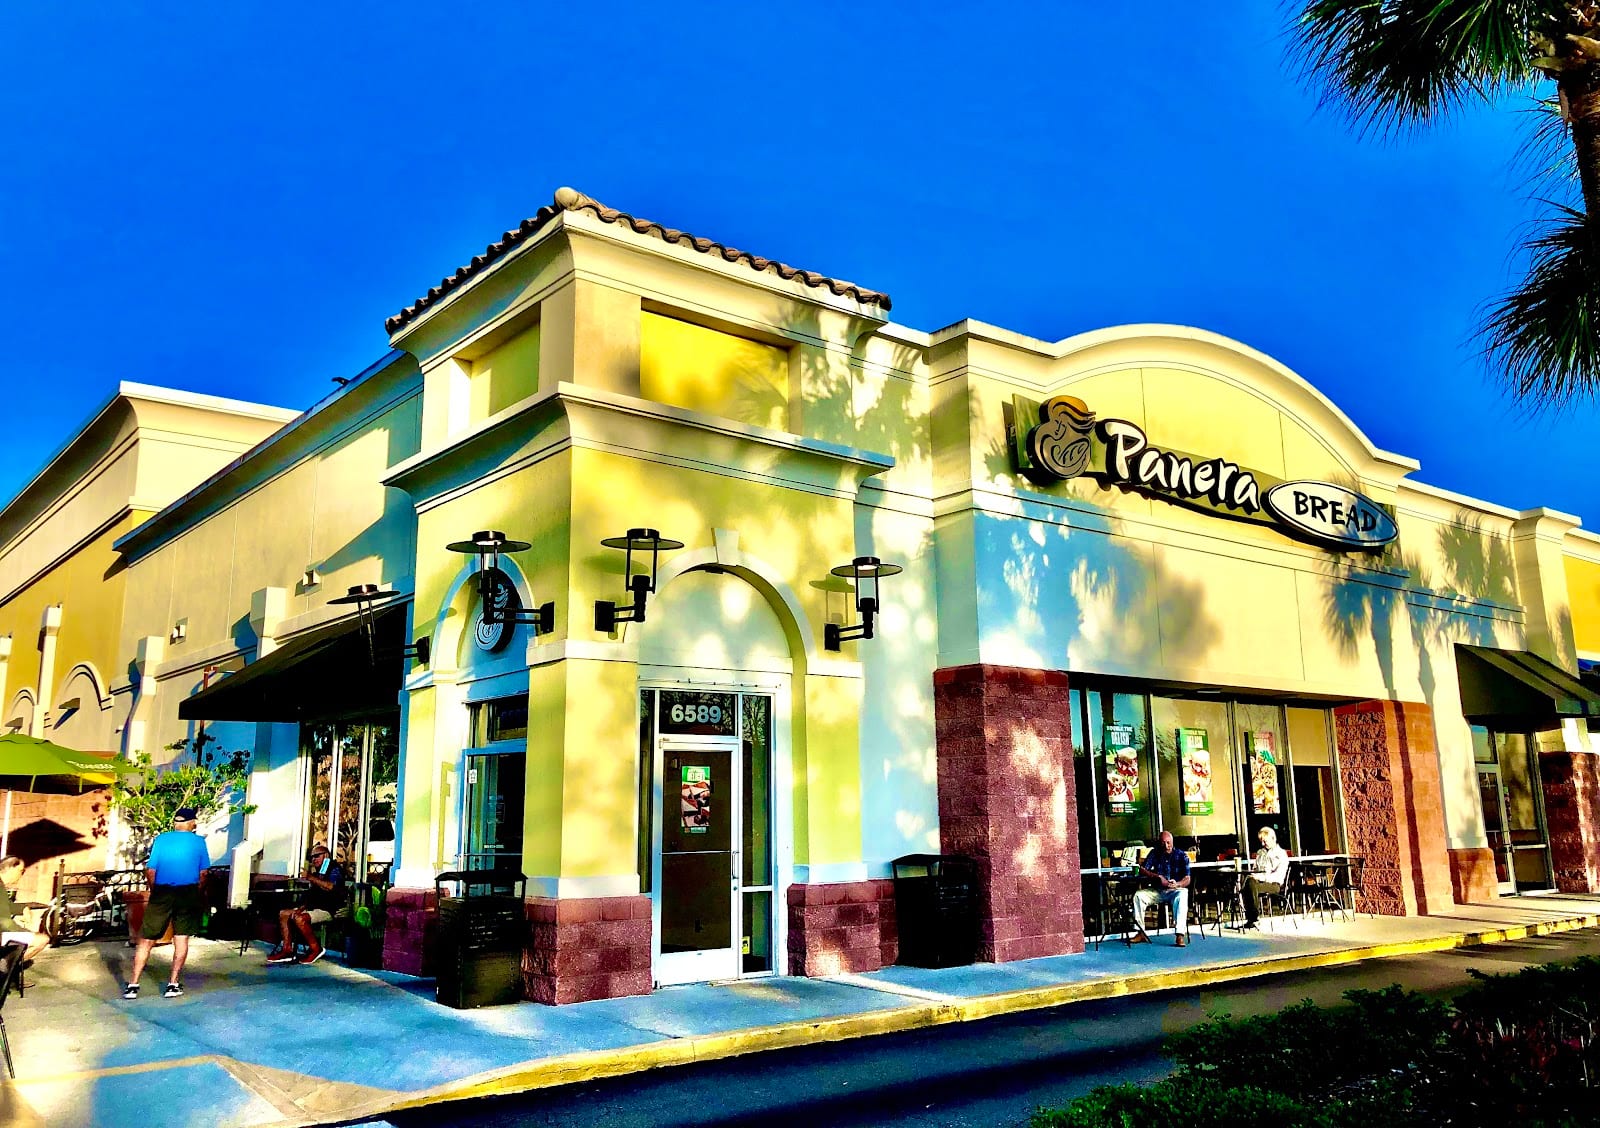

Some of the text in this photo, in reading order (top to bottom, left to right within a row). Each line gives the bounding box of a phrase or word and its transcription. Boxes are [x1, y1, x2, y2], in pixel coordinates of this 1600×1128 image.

[1103, 420, 1378, 533] Panera BREAD
[671, 703, 722, 724] 6589
